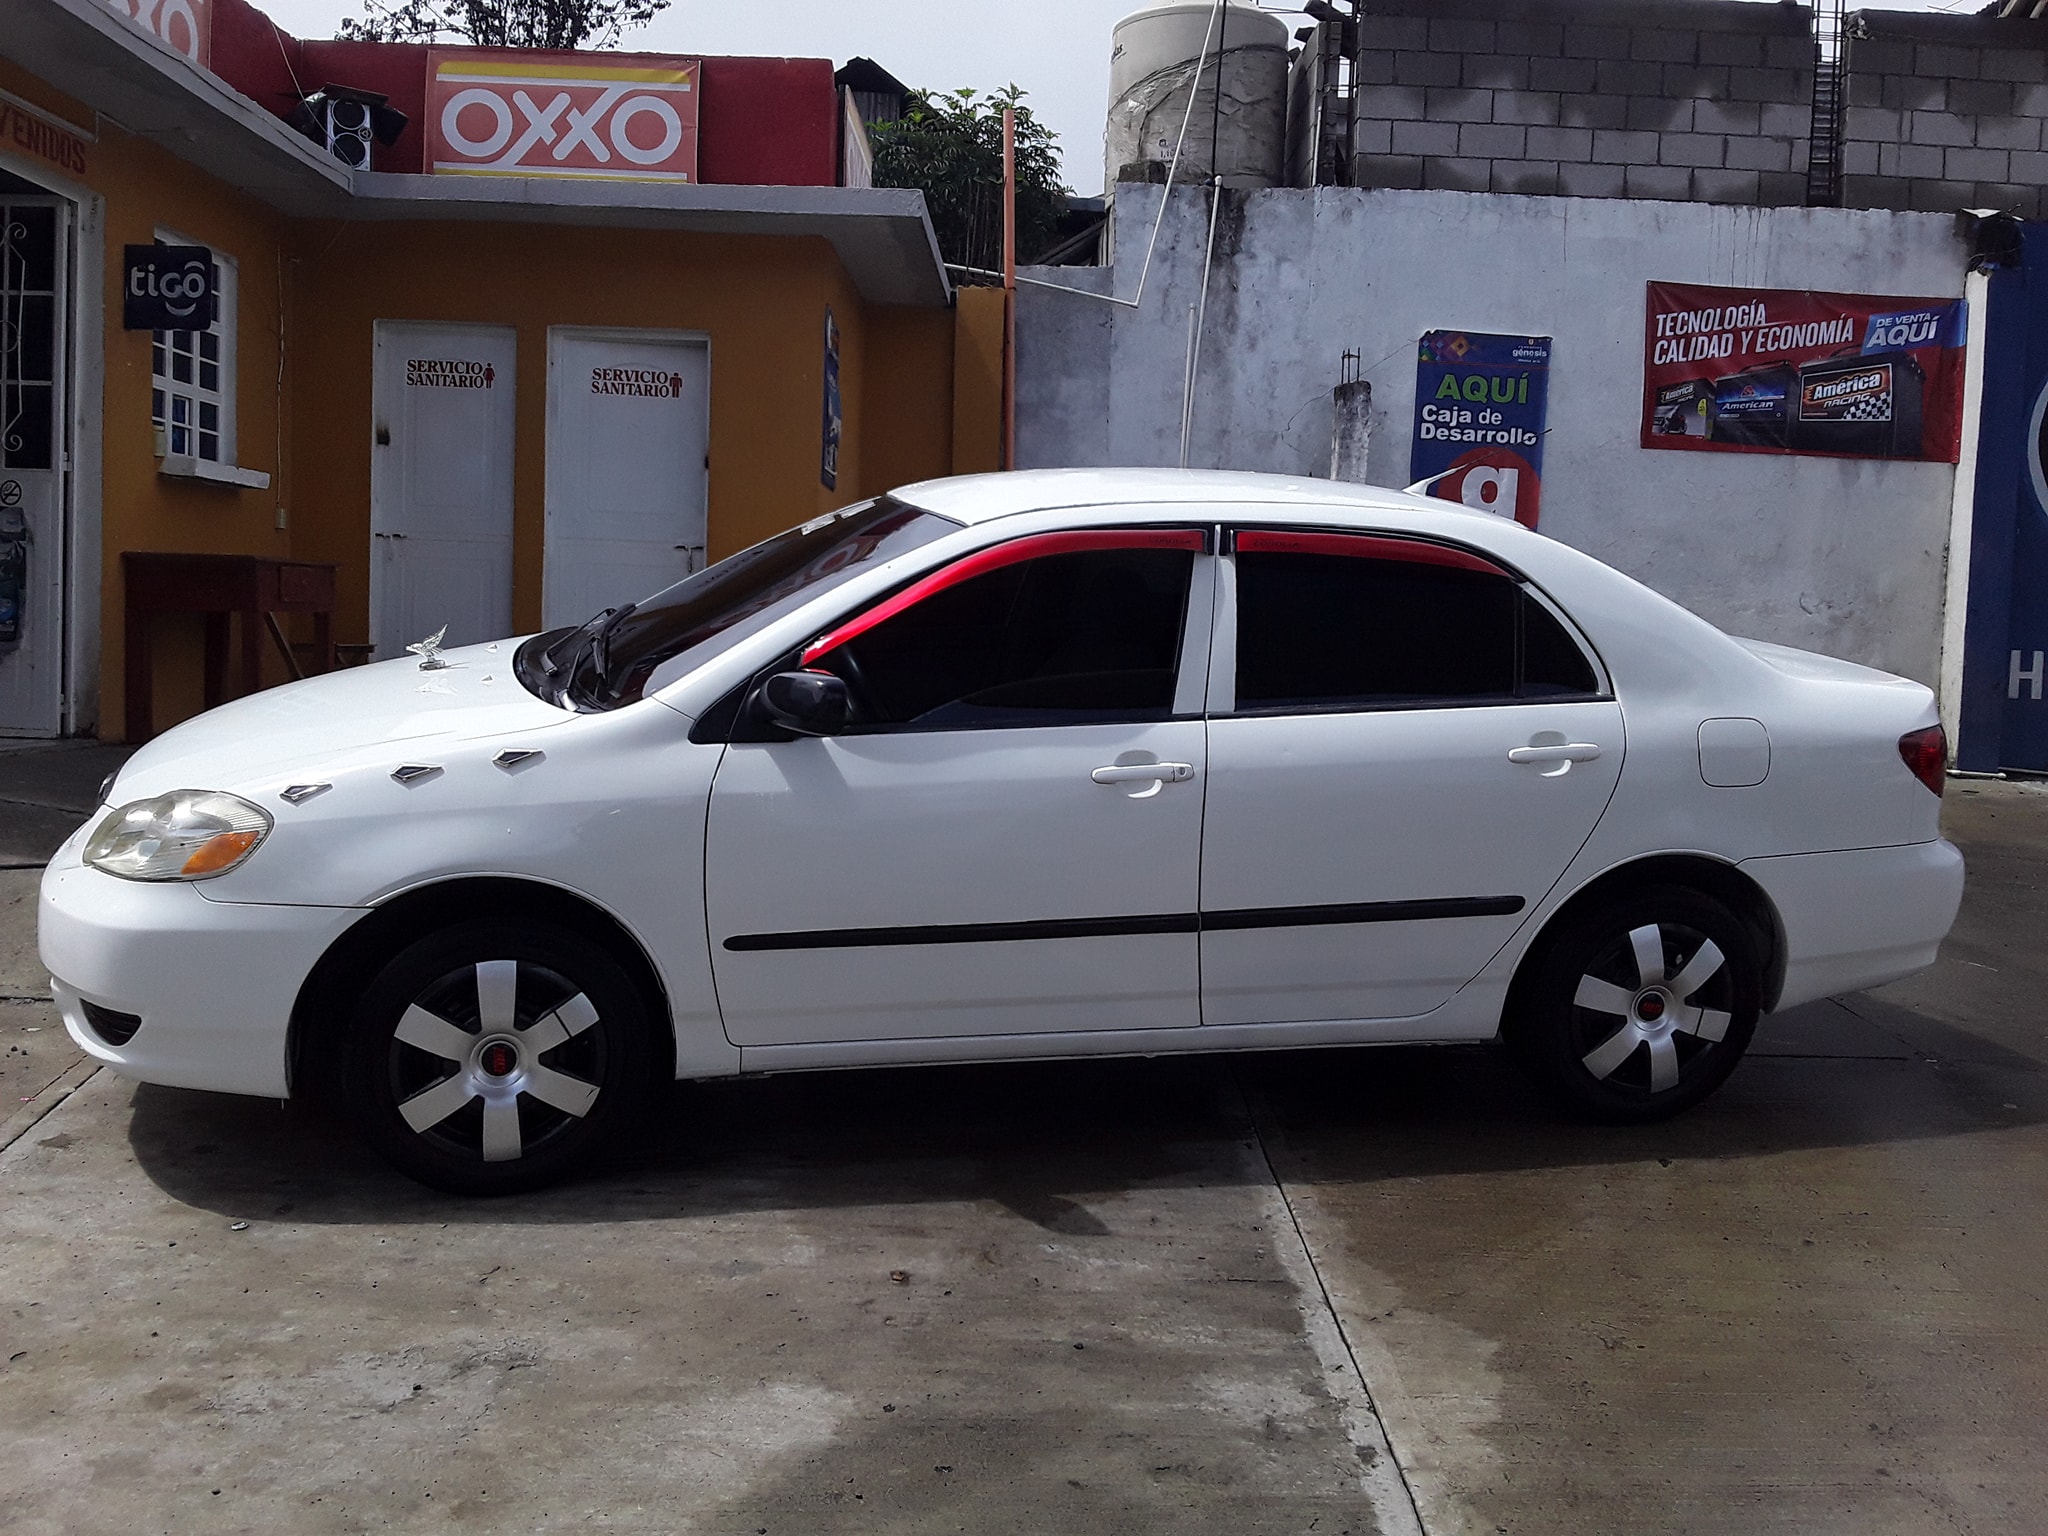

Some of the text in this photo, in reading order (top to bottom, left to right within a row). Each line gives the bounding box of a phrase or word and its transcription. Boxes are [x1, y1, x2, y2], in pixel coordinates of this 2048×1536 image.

[441, 88, 682, 165] OXXO
[1656, 299, 1767, 337] TECNOLOGÍA
[1876, 312, 1932, 328] DE VENTA
[1653, 313, 1855, 366] CALIDAD Y ECONOMÍA
[1866, 315, 1940, 348] AQUÍ
[406, 359, 483, 375] SERVICIO
[592, 367, 669, 384] SERVICIO
[406, 373, 484, 389] SANITARIO
[591, 381, 670, 398] SANITARIO
[1435, 372, 1529, 404] AQUÍ
[1813, 373, 1881, 400] América
[1422, 405, 1502, 426] Caja de
[1721, 400, 1774, 411] American
[1420, 423, 1537, 445] Desarrollo
